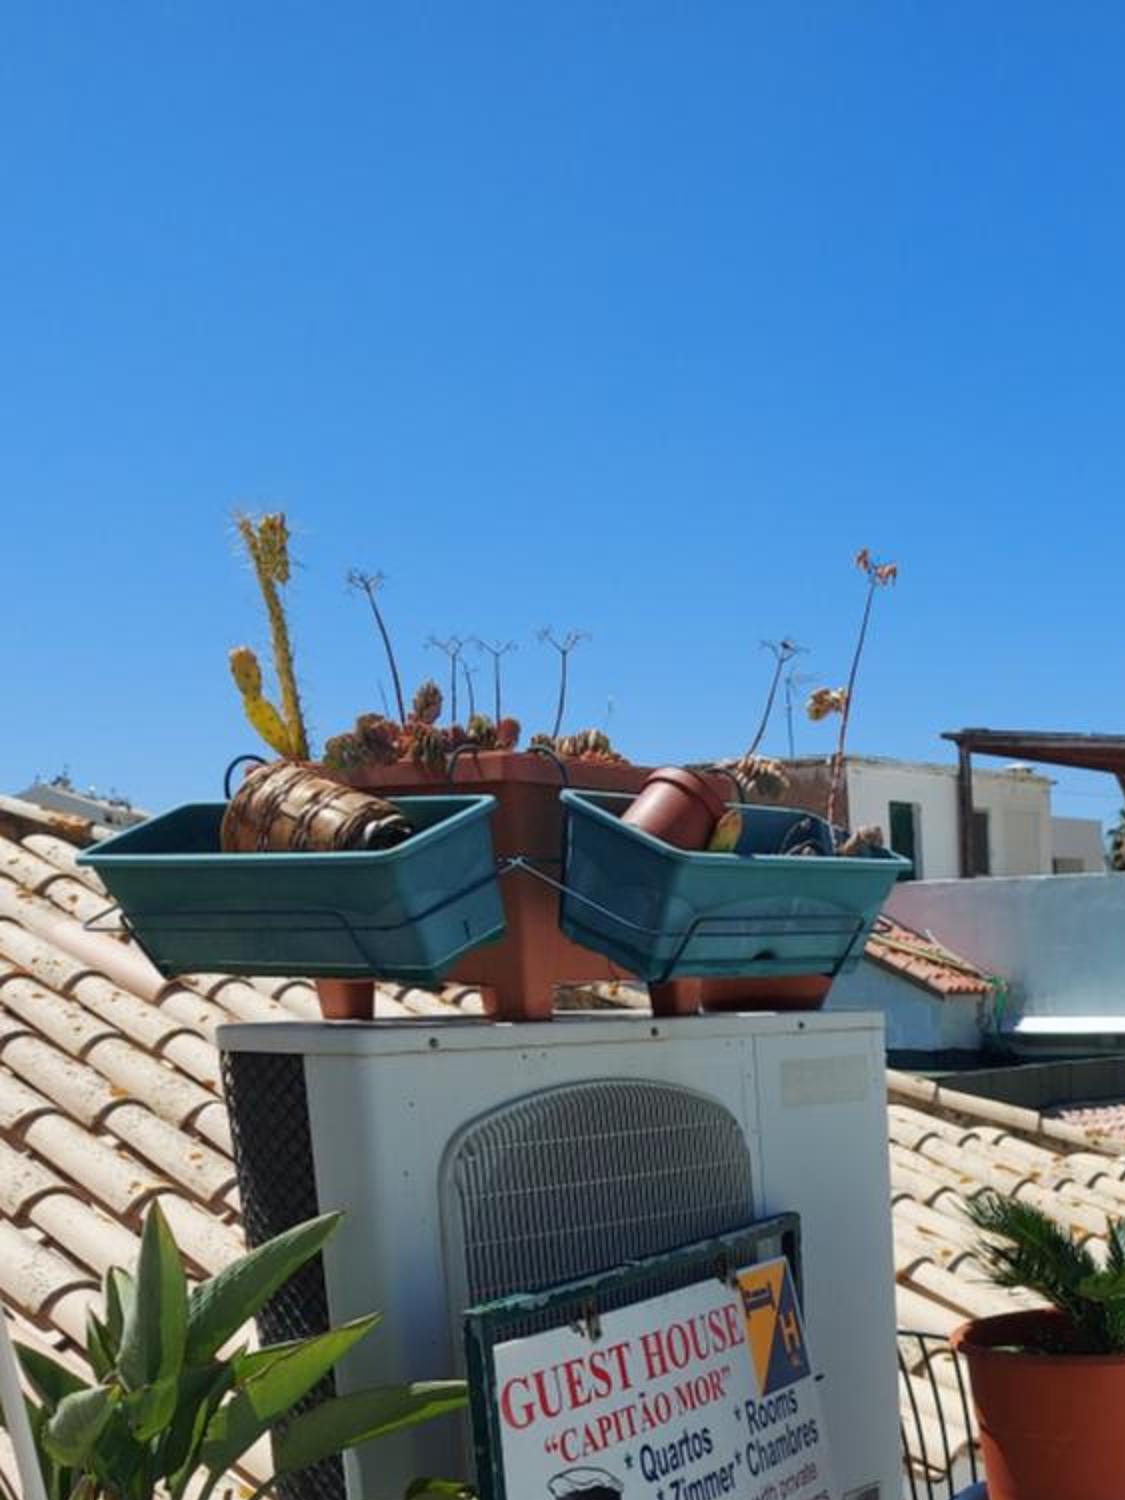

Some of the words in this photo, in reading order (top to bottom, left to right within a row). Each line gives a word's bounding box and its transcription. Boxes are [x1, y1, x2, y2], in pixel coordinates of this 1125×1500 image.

[501, 1342, 634, 1430] GUEST
[640, 1303, 745, 1380] HOUSE
[640, 1427, 714, 1482] Quartos
[744, 1388, 799, 1436] Rooms
[745, 1419, 819, 1478] Chambres
